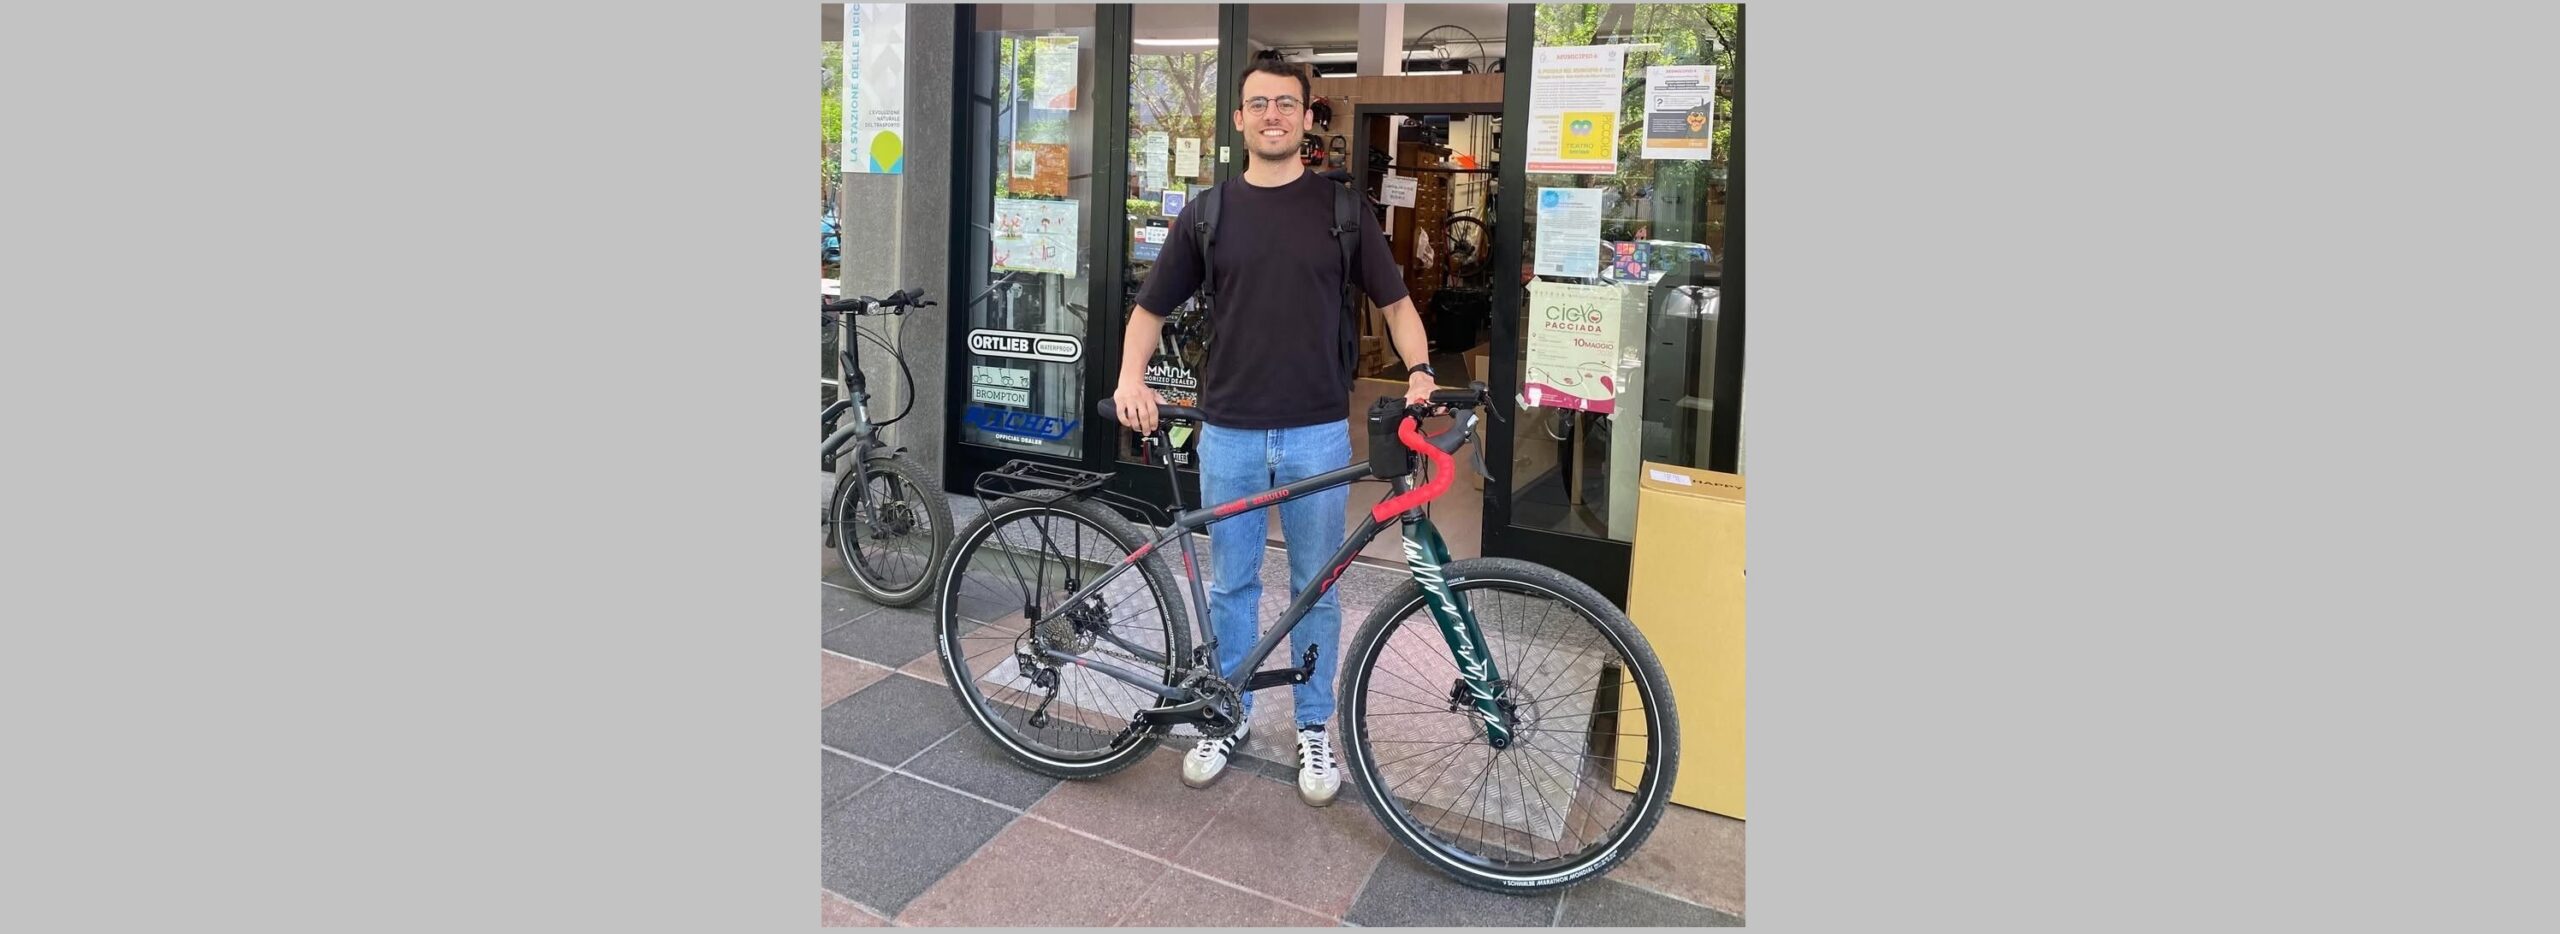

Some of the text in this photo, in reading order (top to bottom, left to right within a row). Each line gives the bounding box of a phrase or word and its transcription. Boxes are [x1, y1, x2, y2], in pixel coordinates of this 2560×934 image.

[851, 41, 860, 79] DELLE
[851, 83, 859, 145] STAZIONE
[850, 148, 858, 162] LA
[1545, 321, 1602, 333] PACCIADA
[973, 335, 1029, 352] ORTLIEB
[1171, 378, 1195, 386] DEALER
[976, 388, 1025, 403] BROMPTON
[995, 433, 1042, 446] OFFICIAL DEALER
[1537, 876, 1569, 886] MARATHON
[1569, 868, 1594, 880] MONDIAL
